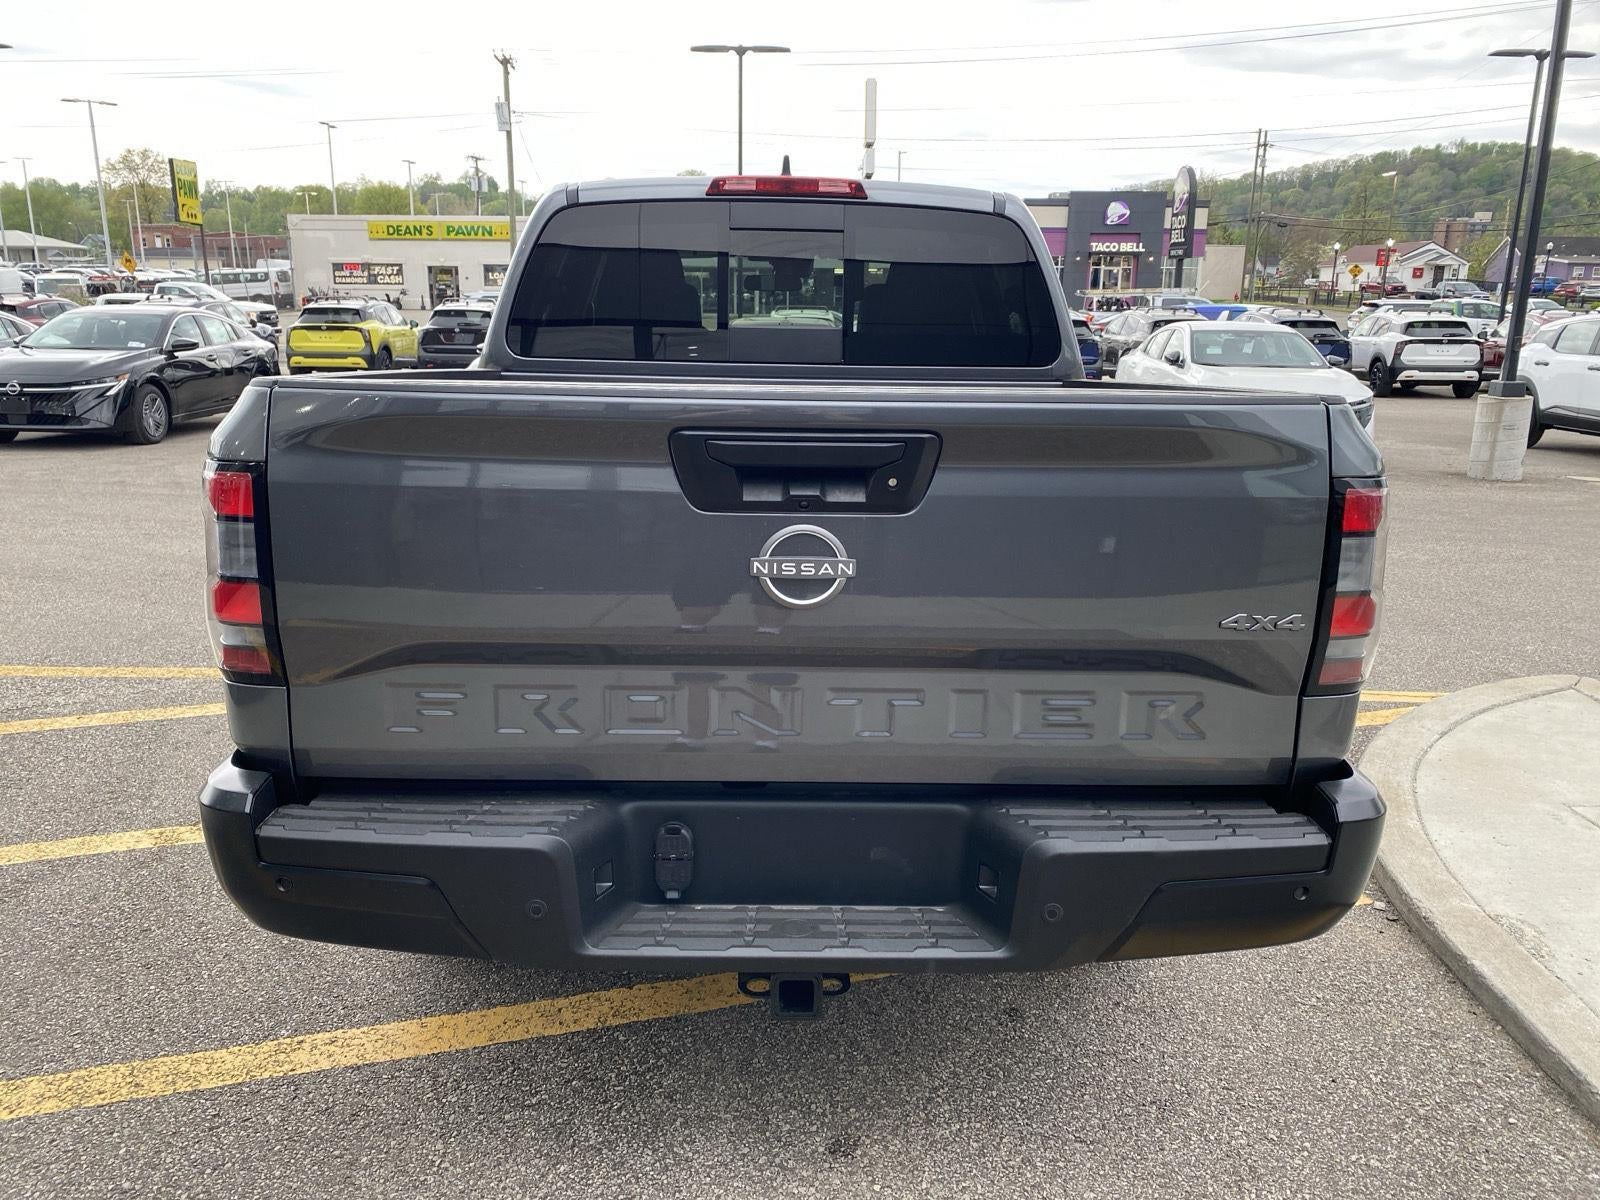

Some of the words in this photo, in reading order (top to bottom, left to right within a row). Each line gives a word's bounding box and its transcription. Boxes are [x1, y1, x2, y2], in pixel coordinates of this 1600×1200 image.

[178, 178, 199, 200] PAWN
[1172, 215, 1186, 229] TACO
[386, 224, 433, 236] DEAN'S
[446, 225, 493, 237] PAWN
[1171, 229, 1185, 243] BELL
[1090, 242, 1119, 252] TACO
[1119, 242, 1146, 252] BELL
[374, 266, 400, 275] FAST
[488, 272, 505, 280] LOA
[335, 276, 368, 284] DIAMONDS
[377, 275, 403, 284] CASH
[753, 561, 854, 576] NISSAN
[384, 682, 1207, 741] FRONTIER
